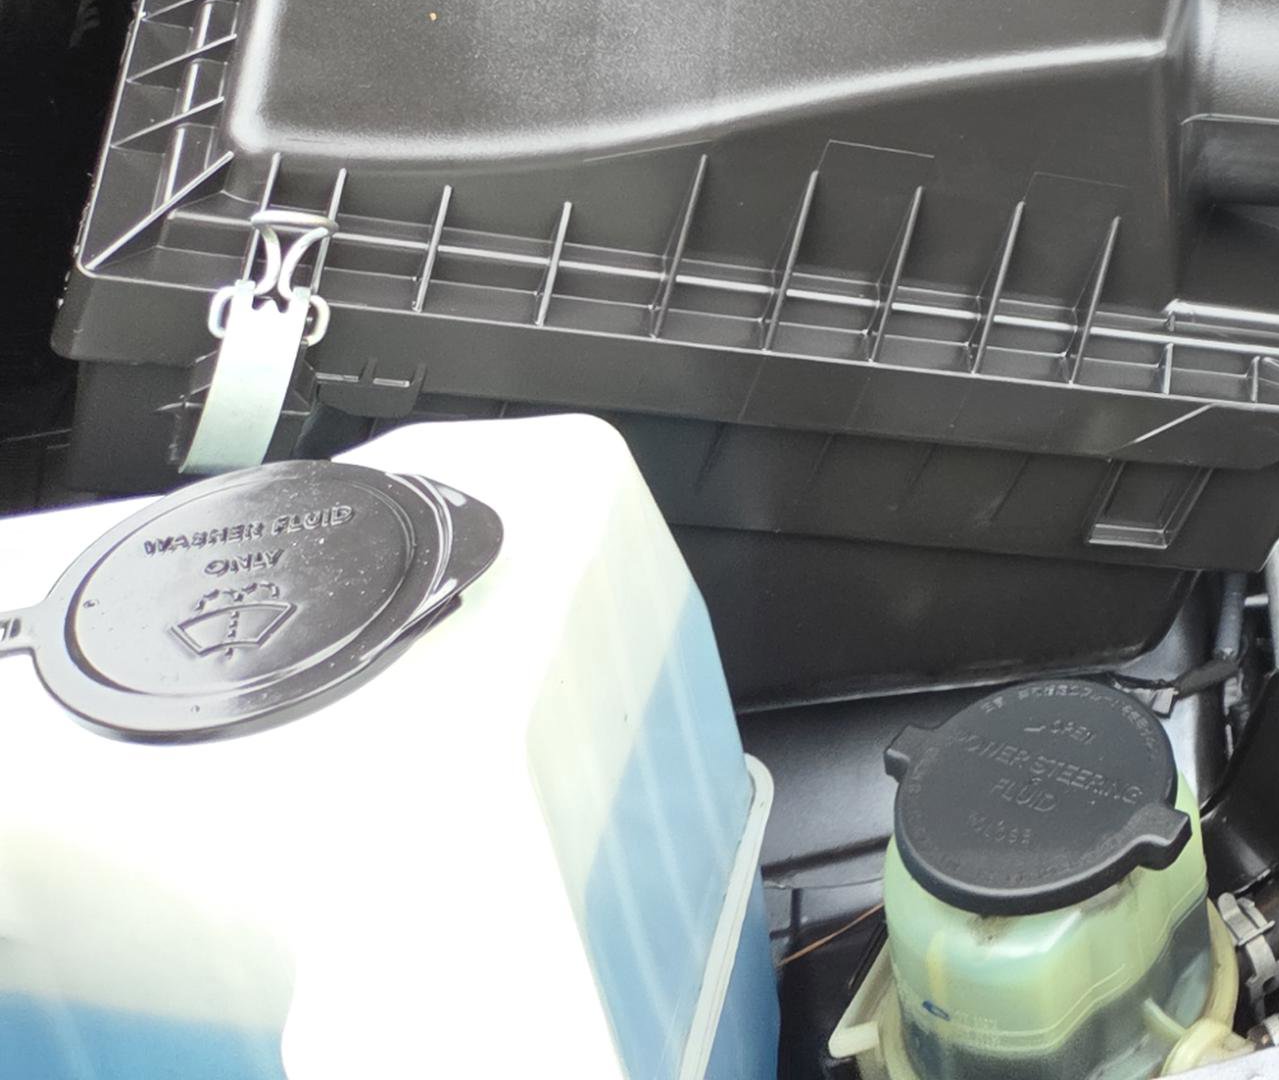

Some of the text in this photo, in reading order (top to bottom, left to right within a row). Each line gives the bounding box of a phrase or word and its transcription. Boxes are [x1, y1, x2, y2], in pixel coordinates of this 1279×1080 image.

[271, 504, 355, 537] FLUID
[203, 548, 285, 577] ONLY
[991, 777, 1058, 813] FLUID
[1030, 755, 1144, 806] STEERING
